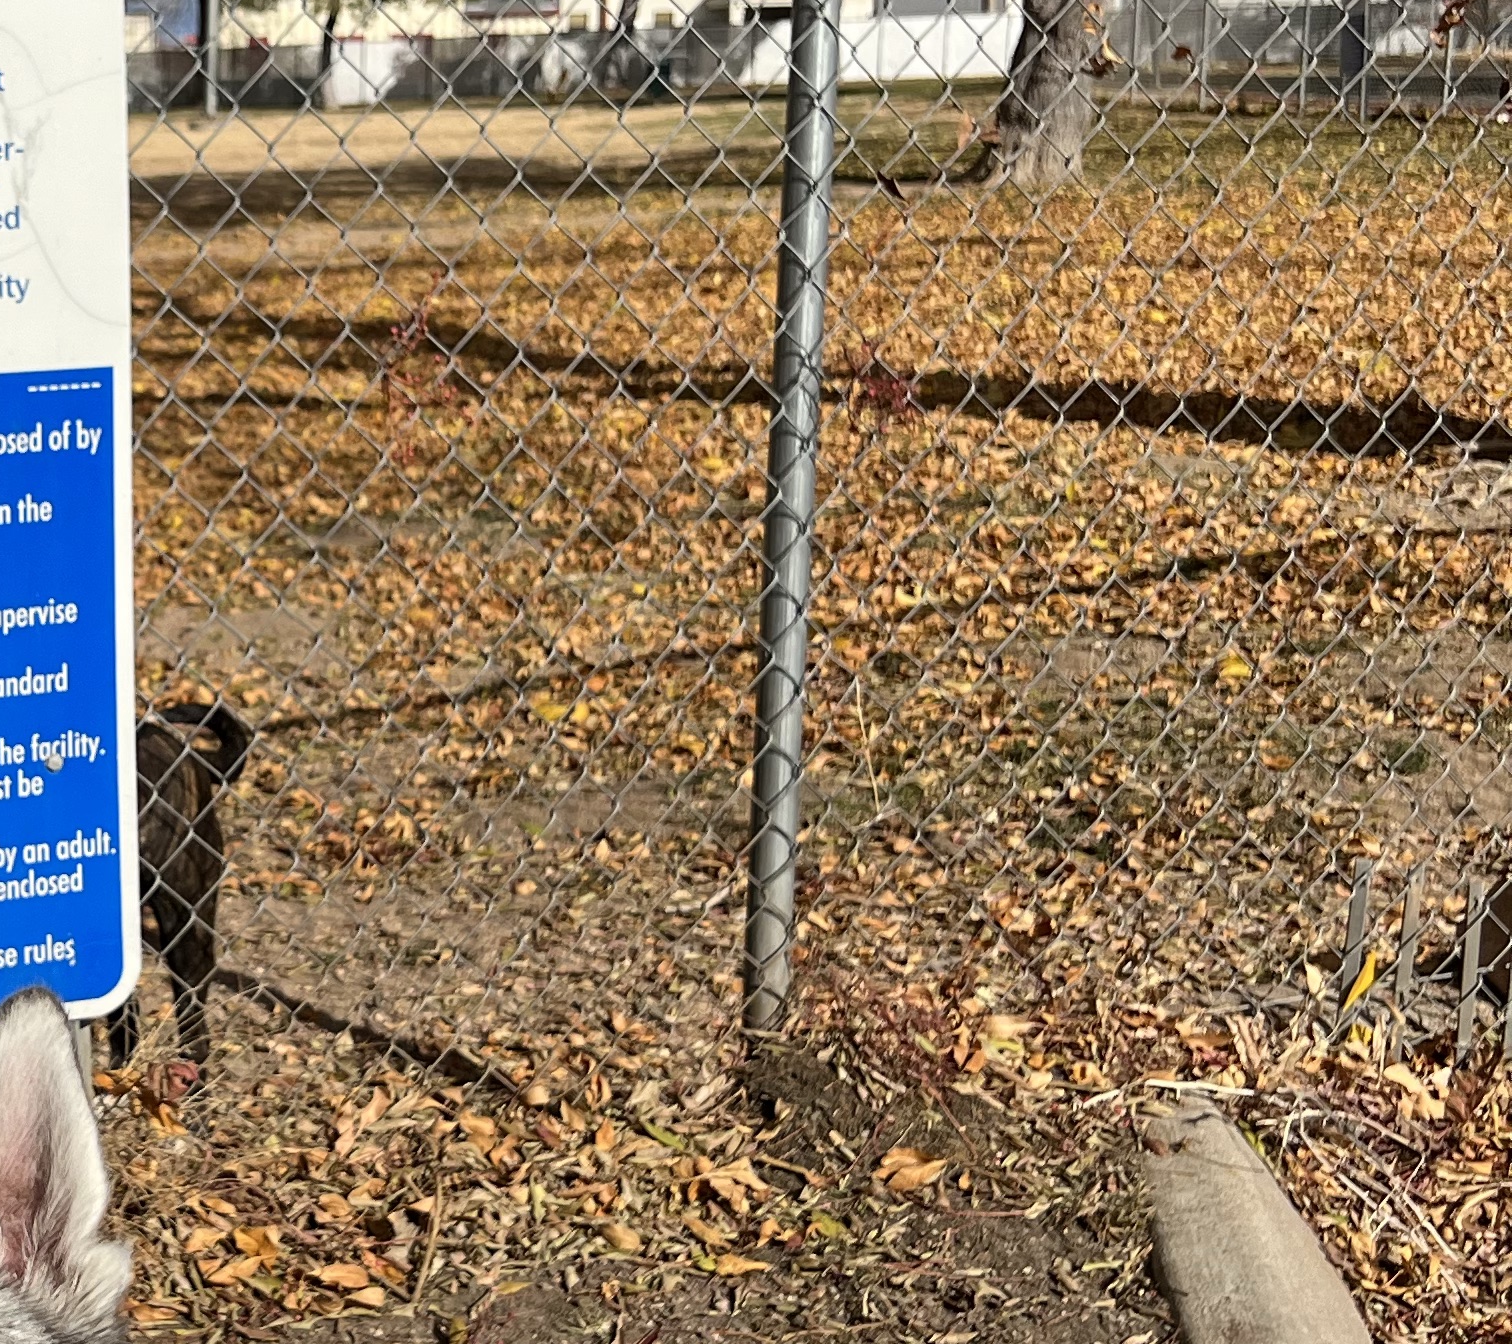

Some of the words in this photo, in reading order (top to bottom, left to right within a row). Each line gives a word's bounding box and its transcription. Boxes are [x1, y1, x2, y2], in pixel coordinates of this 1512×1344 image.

[48, 419, 71, 451] of
[75, 419, 102, 455] by
[17, 493, 52, 523] the
[22, 842, 50, 864] an
[56, 827, 117, 860] adult.
